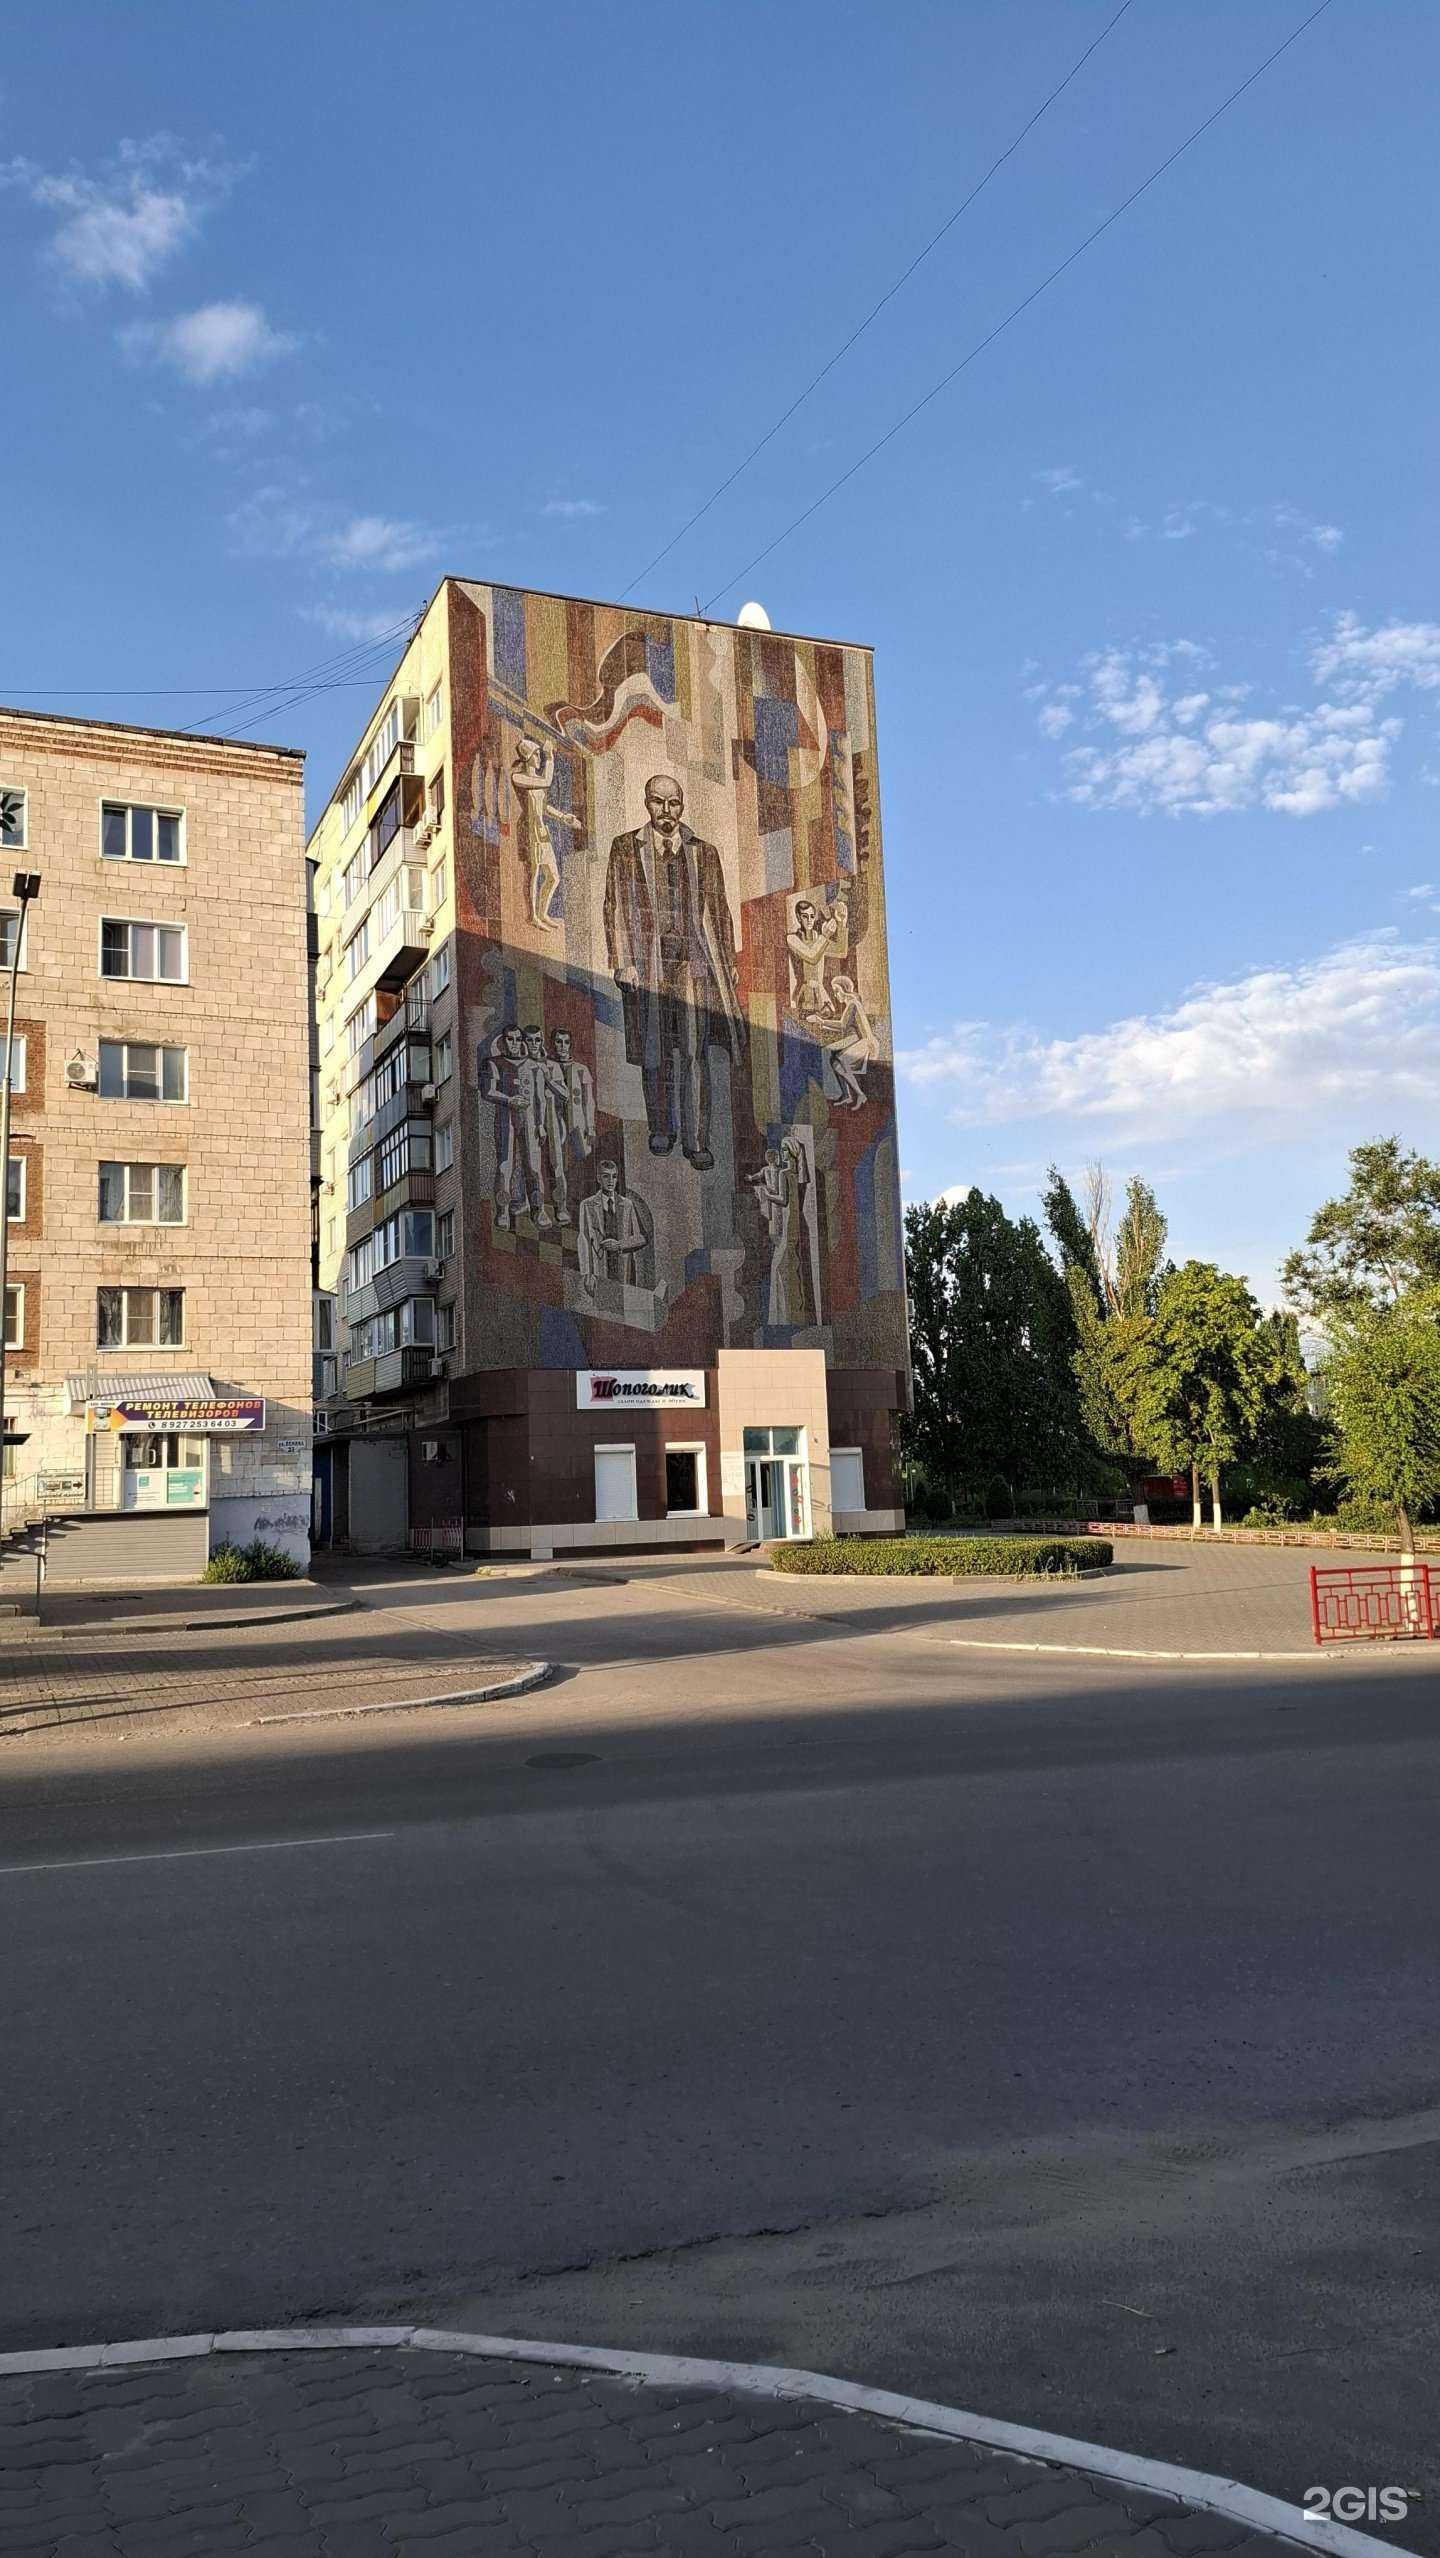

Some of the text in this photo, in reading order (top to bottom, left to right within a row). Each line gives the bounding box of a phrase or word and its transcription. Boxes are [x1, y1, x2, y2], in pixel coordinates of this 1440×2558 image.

[593, 1378, 694, 1399] Шопоголик
[126, 1402, 178, 1411] РЕМОНТ
[184, 1401, 261, 1410] ТЕЛЕФОНОВ
[146, 1410, 239, 1419] ТЕЛЕВИЗОРОВ
